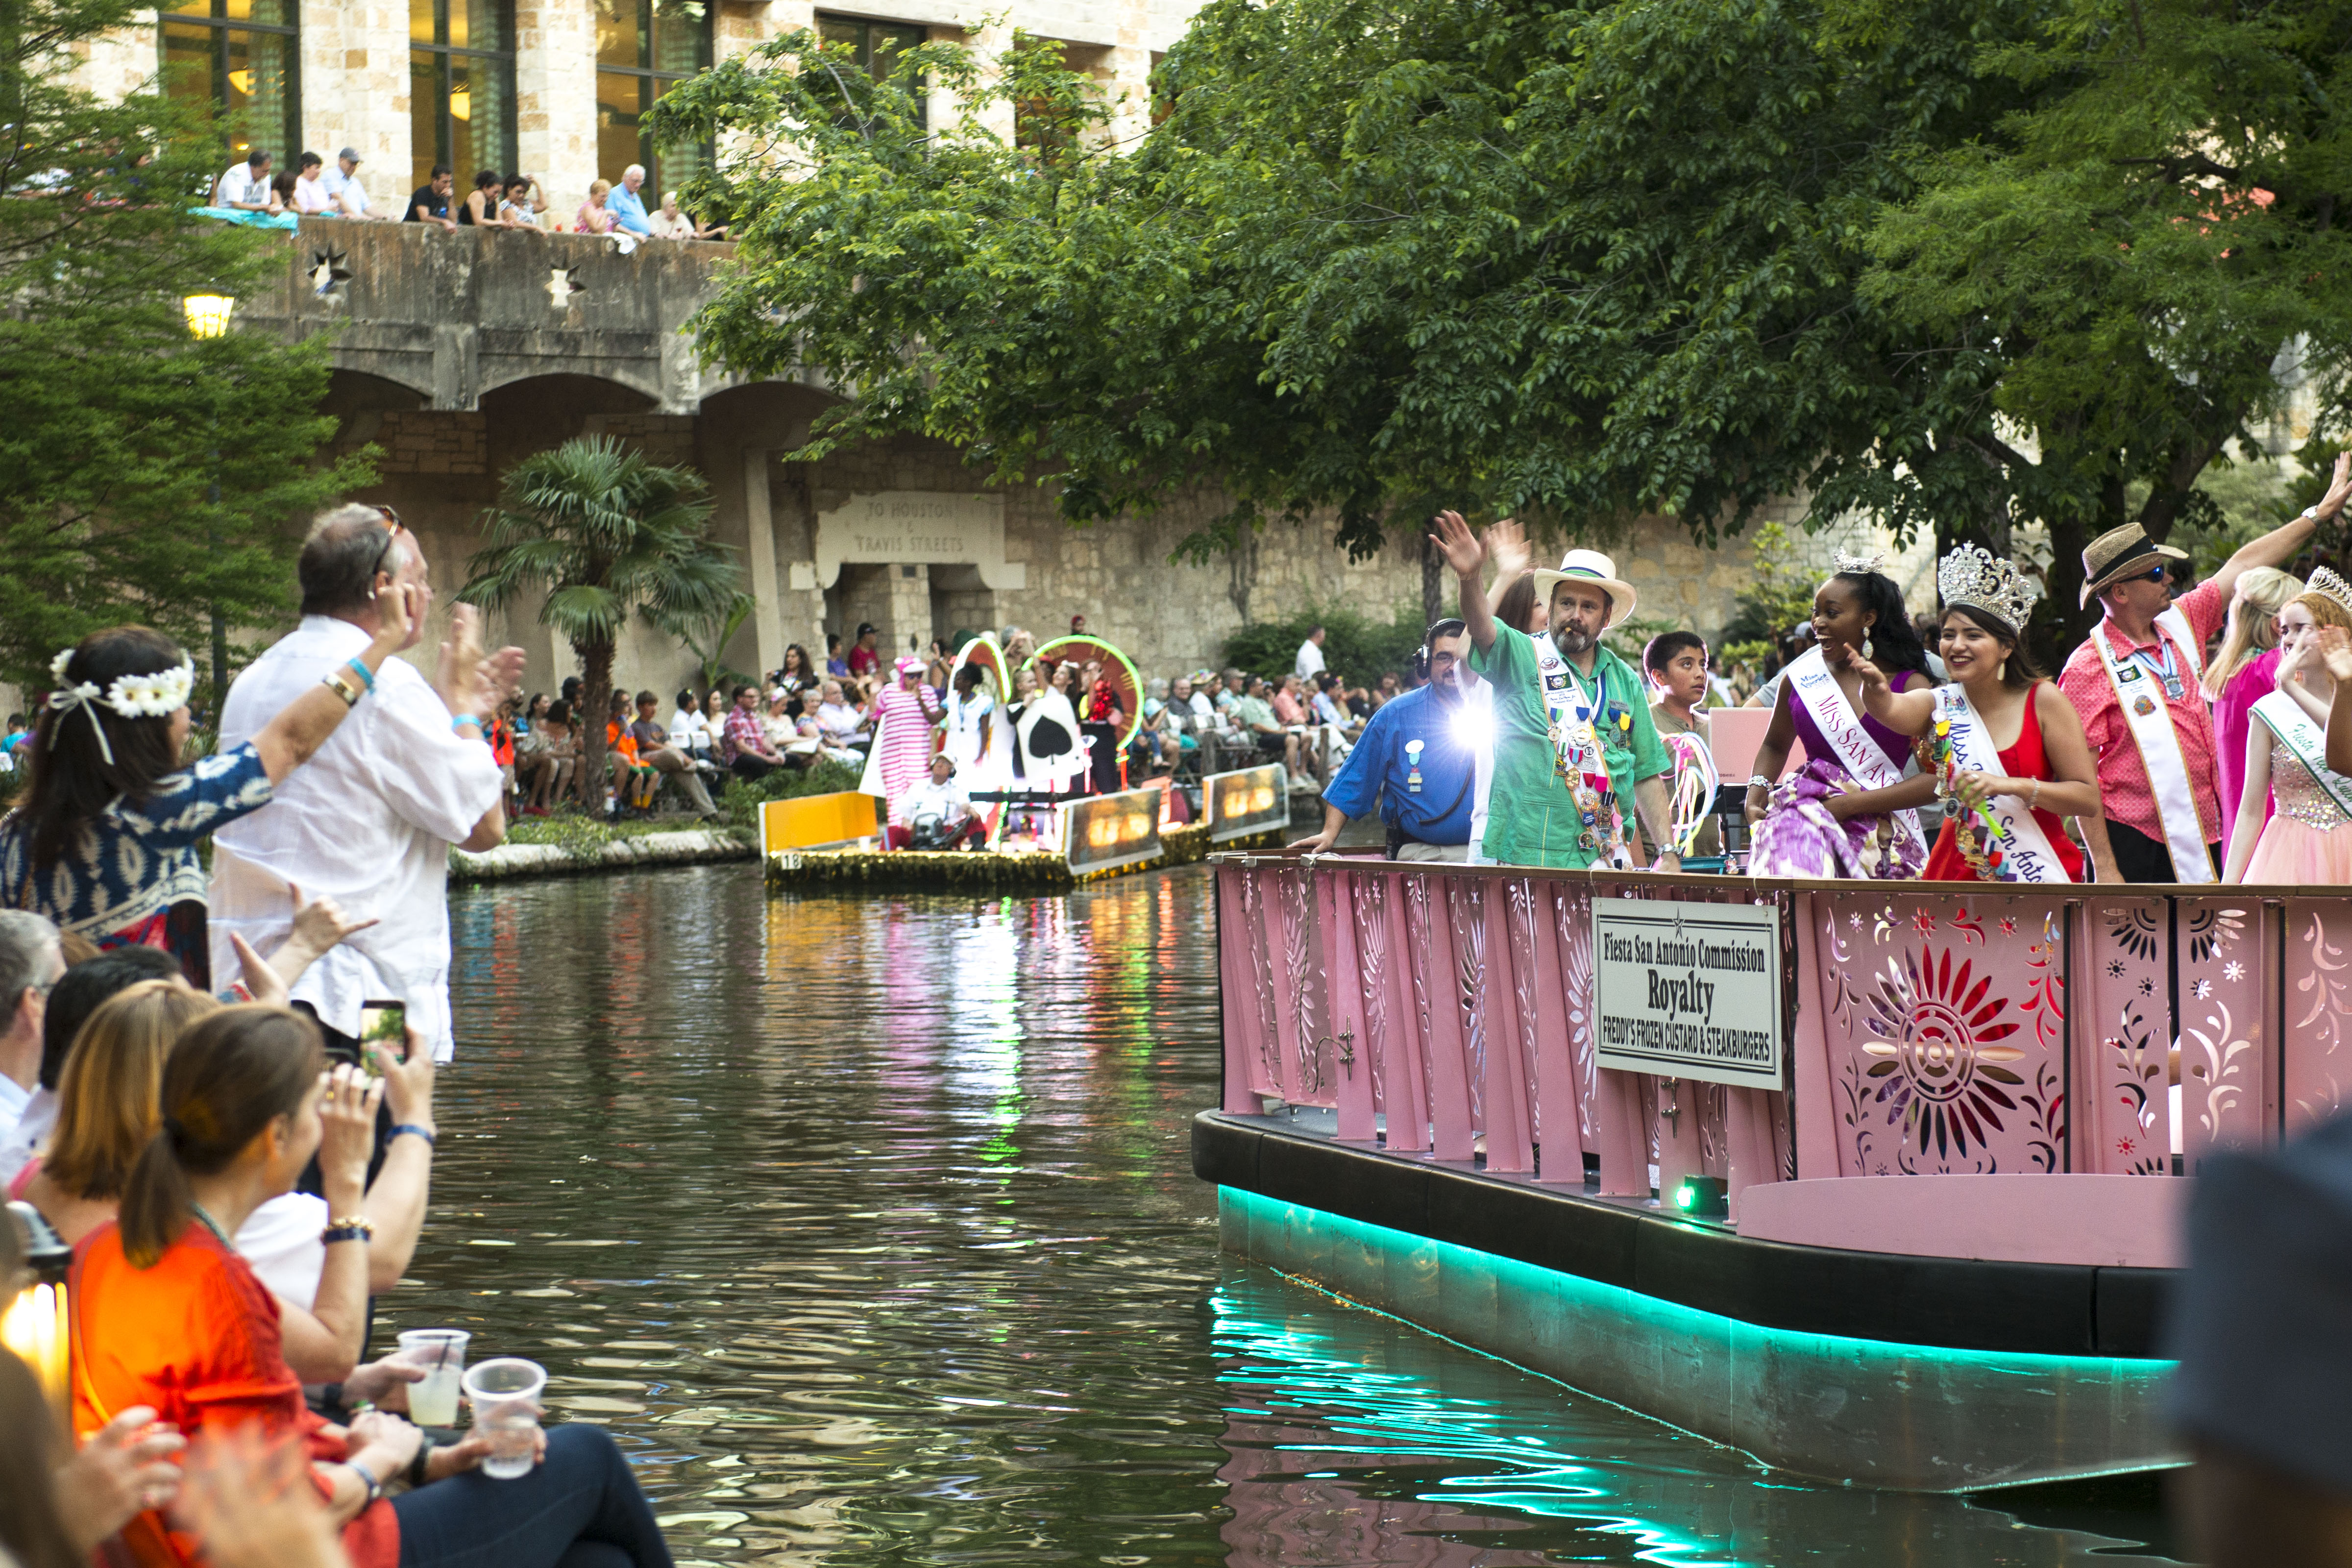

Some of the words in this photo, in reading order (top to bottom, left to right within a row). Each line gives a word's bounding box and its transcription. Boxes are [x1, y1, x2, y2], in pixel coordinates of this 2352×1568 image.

[855, 535, 903, 552] TRAVIS
[909, 536, 964, 552] STREETS
[1814, 677, 1830, 689] 2018
[1815, 694, 1845, 732] MISS
[1838, 728, 1872, 766] SAN
[1950, 719, 1971, 764] Miss
[2288, 724, 2314, 751] Fiesta
[785, 855, 799, 868] 18
[1604, 932, 1633, 962] Fiesta
[1635, 934, 1653, 964] San
[1656, 936, 1696, 968] Antonio
[1698, 938, 1765, 973] Commission
[1648, 969, 1715, 1025] Royalty
[1603, 1016, 1635, 1046] FREDDY'S
[1637, 1020, 1664, 1049] FROZEN
[1666, 1023, 1698, 1054] CUSTARD
[1700, 1029, 1706, 1054] &
[1706, 1027, 1770, 1062] STEAKBURGERS
